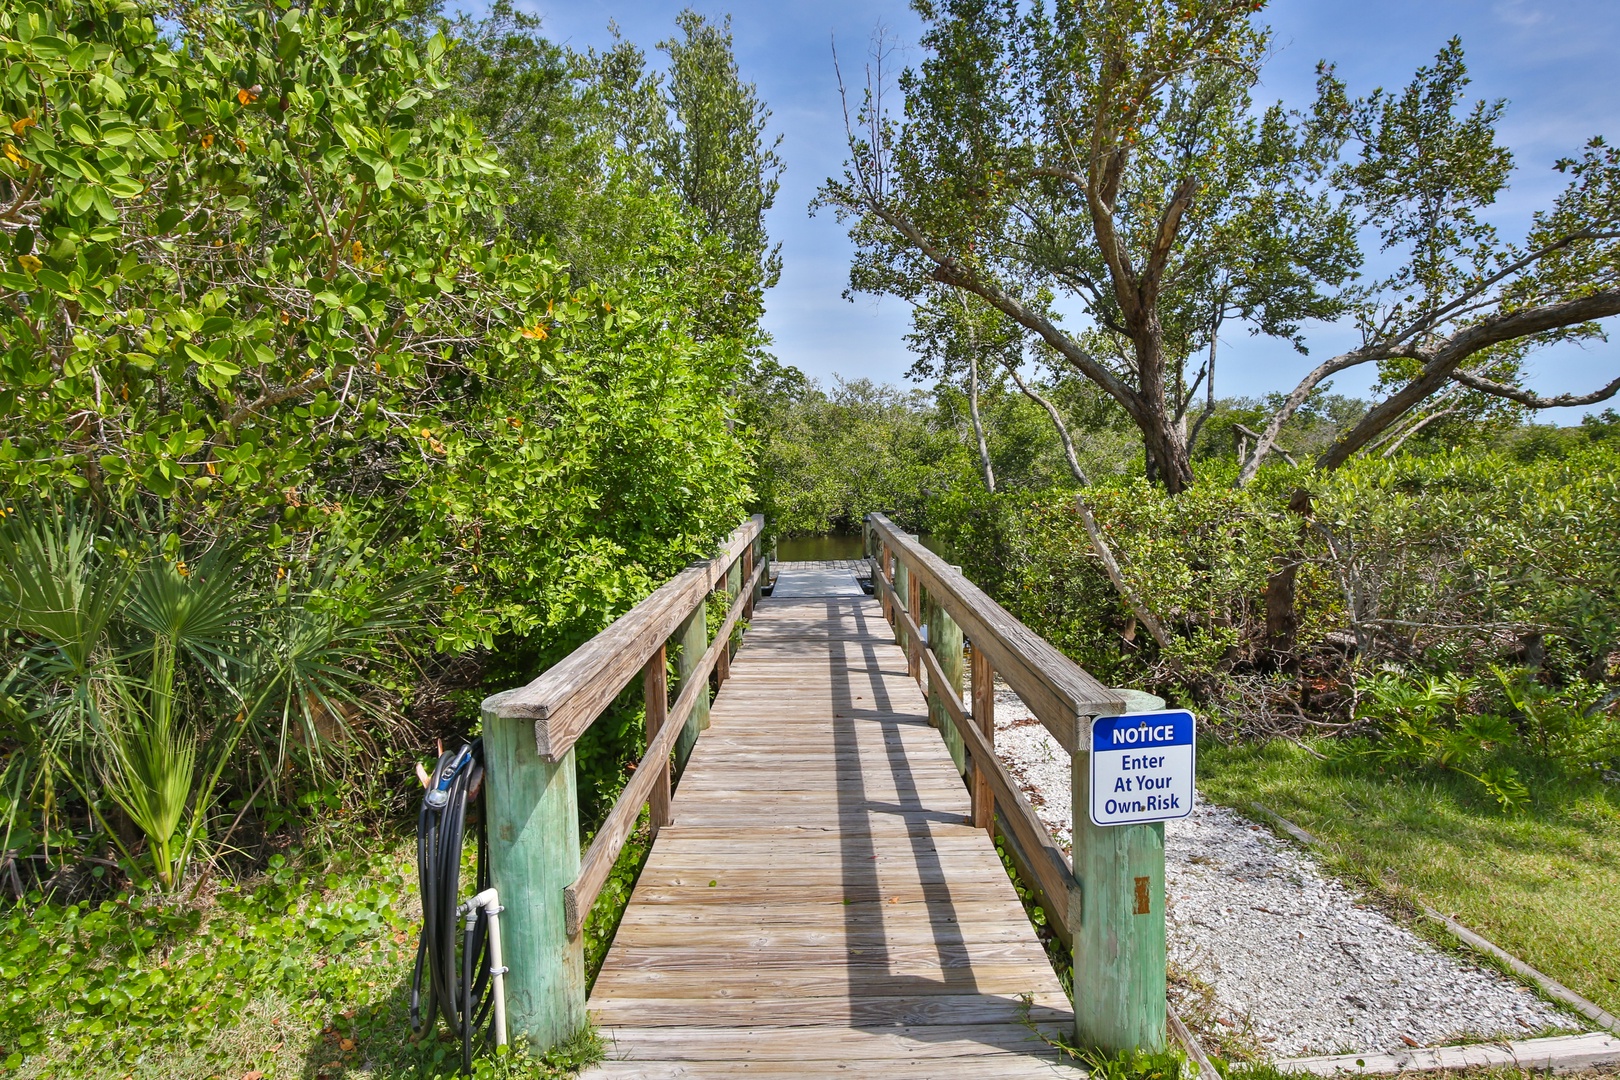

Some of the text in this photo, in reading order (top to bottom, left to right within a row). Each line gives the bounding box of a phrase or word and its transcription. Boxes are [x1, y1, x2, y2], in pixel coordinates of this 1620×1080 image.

[1113, 725, 1174, 744] NOTICE
[1122, 755, 1165, 771] Enter
[1114, 775, 1172, 793] At Your
[1105, 793, 1180, 815] Own Risk
